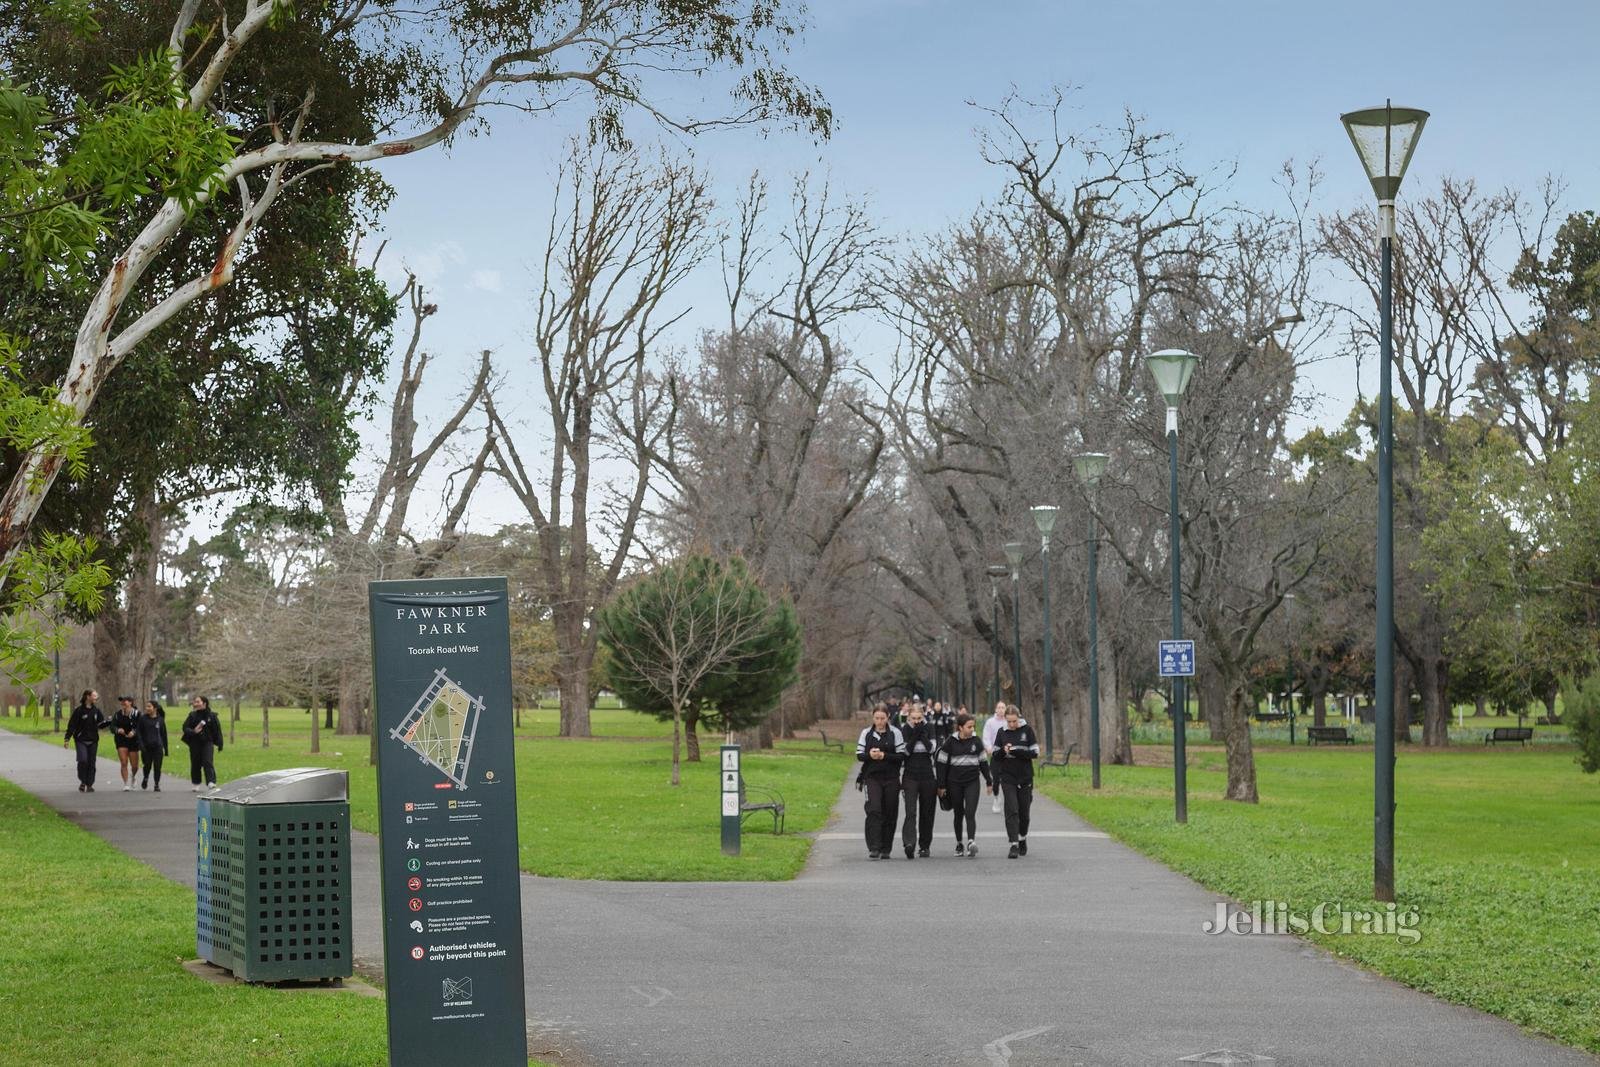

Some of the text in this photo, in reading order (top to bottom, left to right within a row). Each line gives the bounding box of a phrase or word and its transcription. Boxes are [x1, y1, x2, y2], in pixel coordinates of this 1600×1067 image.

[397, 606, 487, 619] FAWKNER
[419, 623, 466, 634] PARK
[429, 943, 467, 952] Authorised
[488, 950, 506, 958] point
